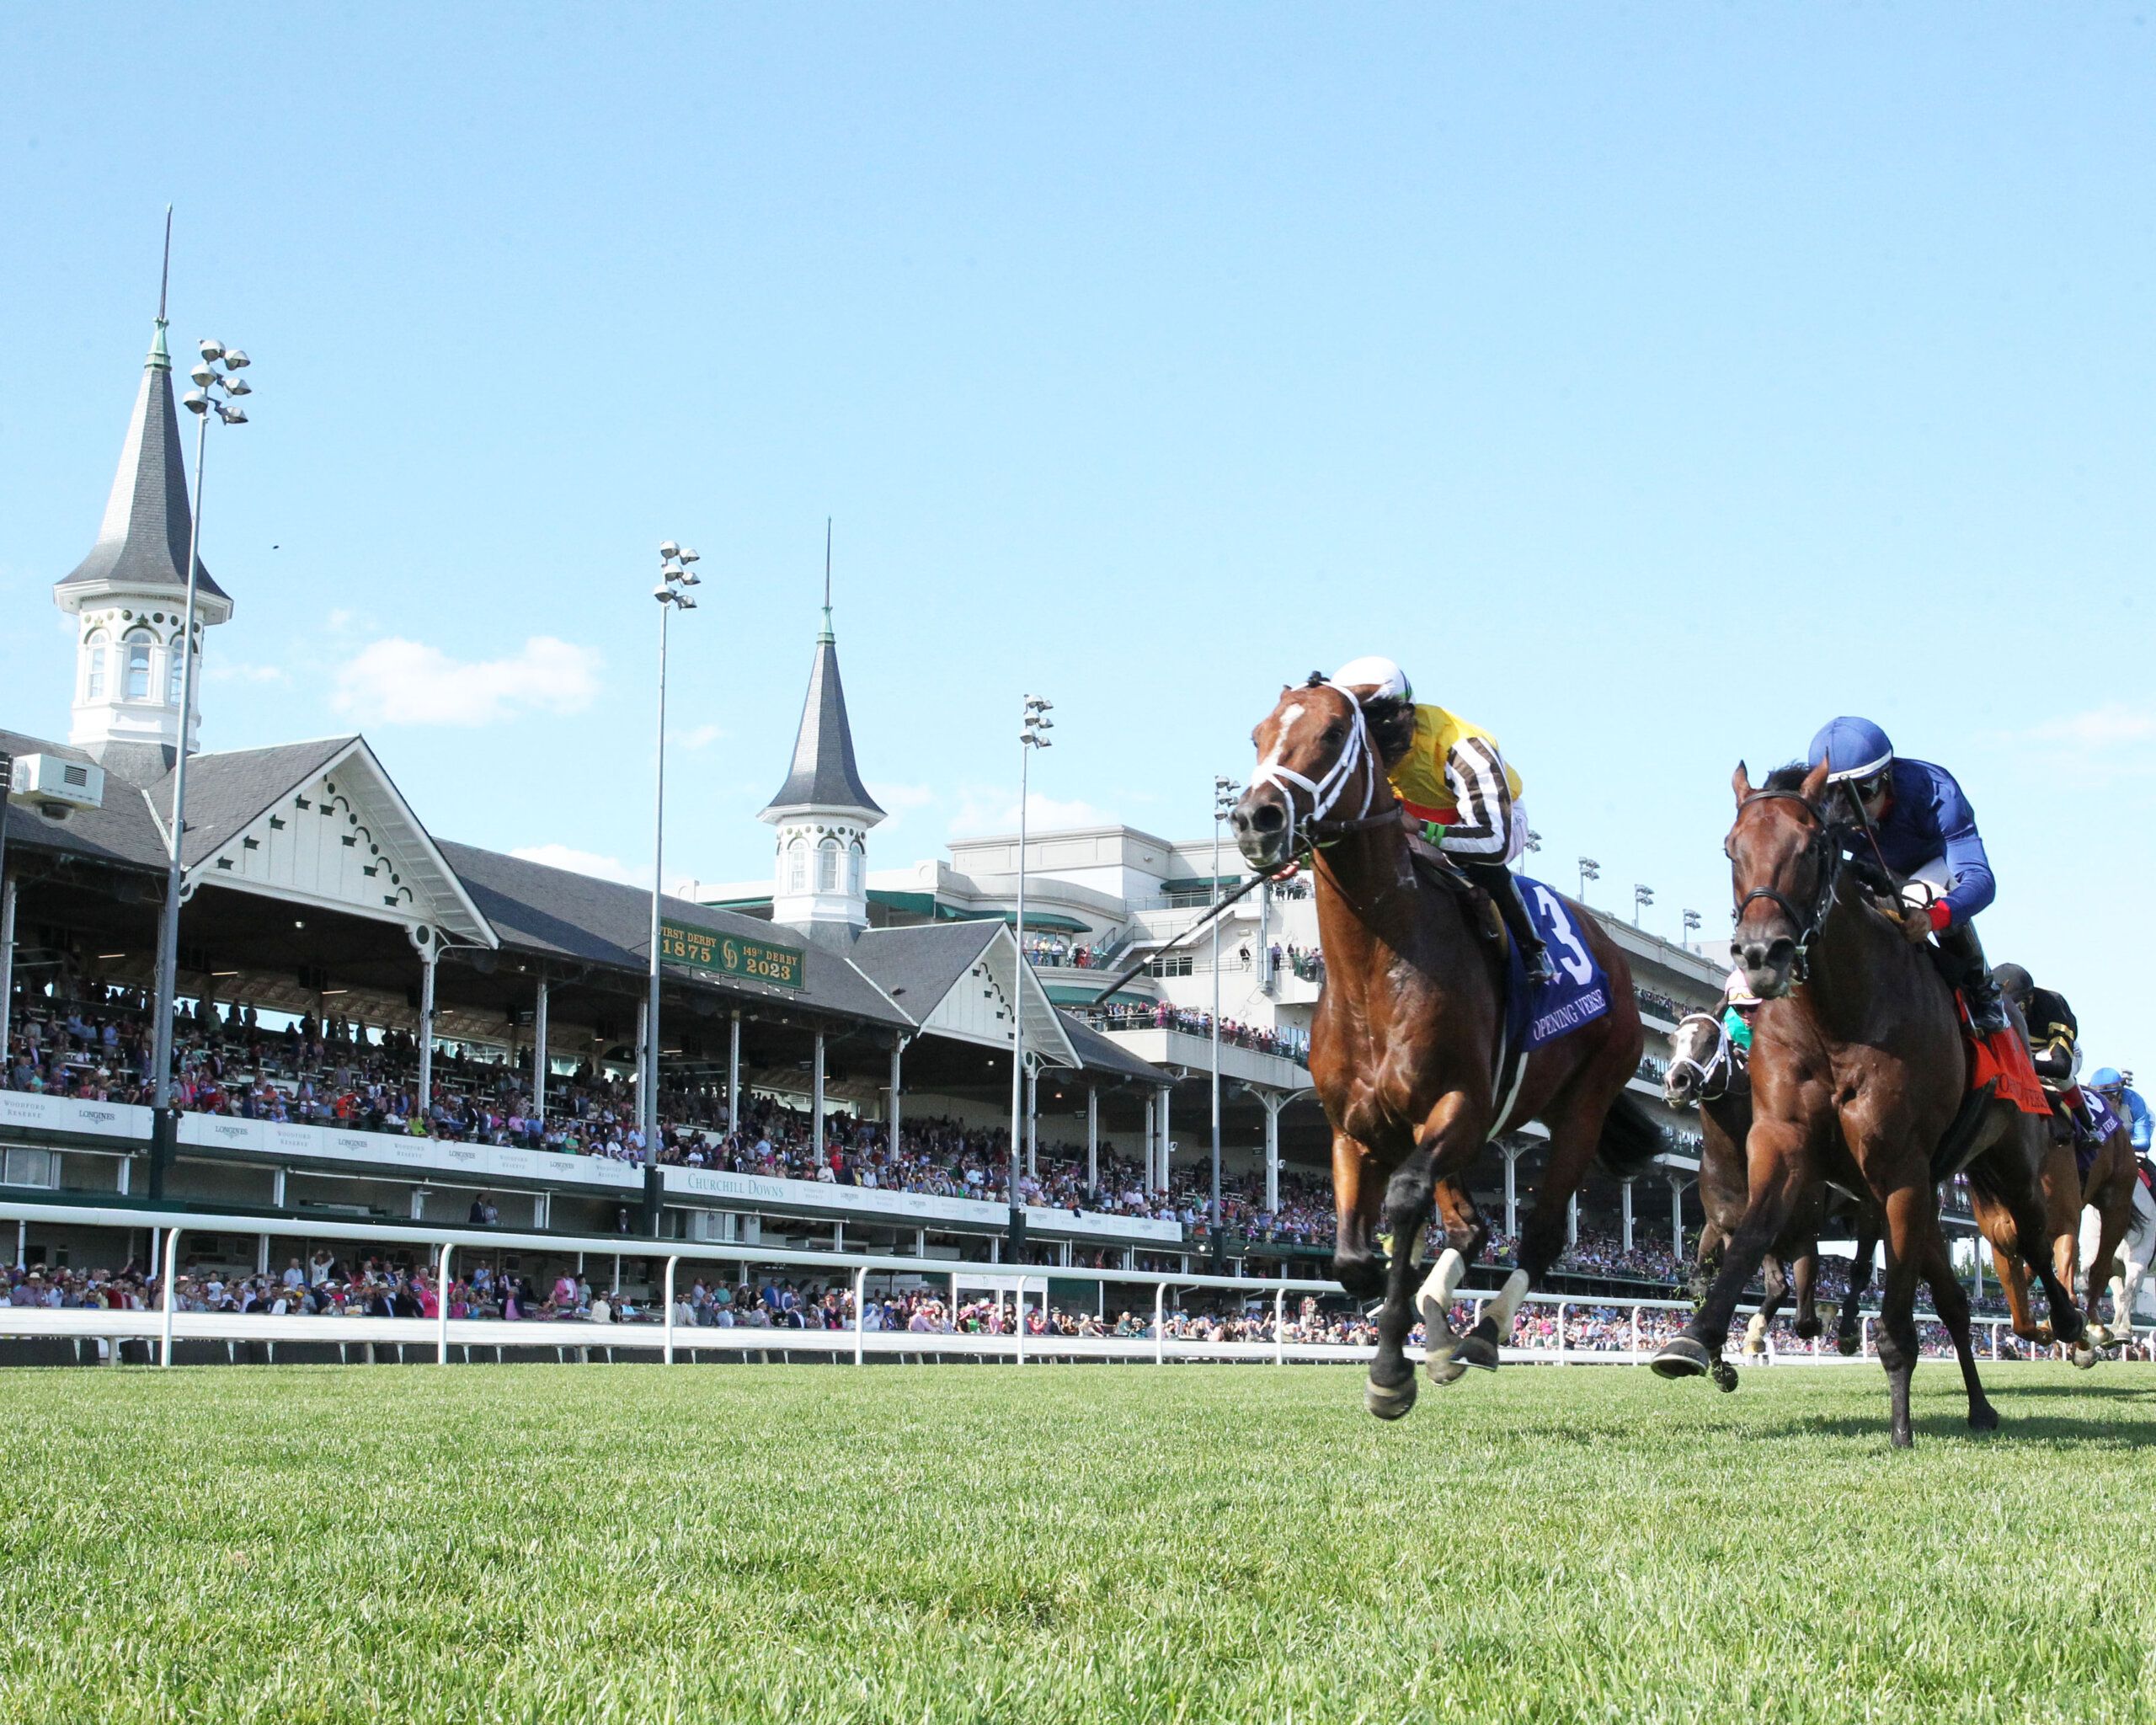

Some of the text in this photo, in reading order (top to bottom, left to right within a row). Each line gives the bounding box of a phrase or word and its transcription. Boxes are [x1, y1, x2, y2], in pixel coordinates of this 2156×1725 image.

[687, 932, 717, 948] DERBY
[1532, 885, 1593, 985] 3
[663, 939, 711, 963] 1875
[766, 950, 798, 966] DERBY
[746, 958, 791, 980] 2023
[1533, 989, 1606, 1041] OPENING VERSE
[4, 1100, 45, 1111] WOODFORD
[8, 1109, 41, 1119] RESERVE
[79, 1110, 115, 1121] LONGINES
[215, 1125, 248, 1135] LONGINES
[277, 1130, 312, 1140] WOODFORD
[280, 1139, 307, 1147] RESERVE
[338, 1138, 367, 1147] LONGINES
[449, 1150, 475, 1159] LONGINES
[550, 1161, 574, 1169] LONGINES
[687, 1172, 745, 1194] CHURCHILL
[748, 1179, 783, 1198] DOWNS
